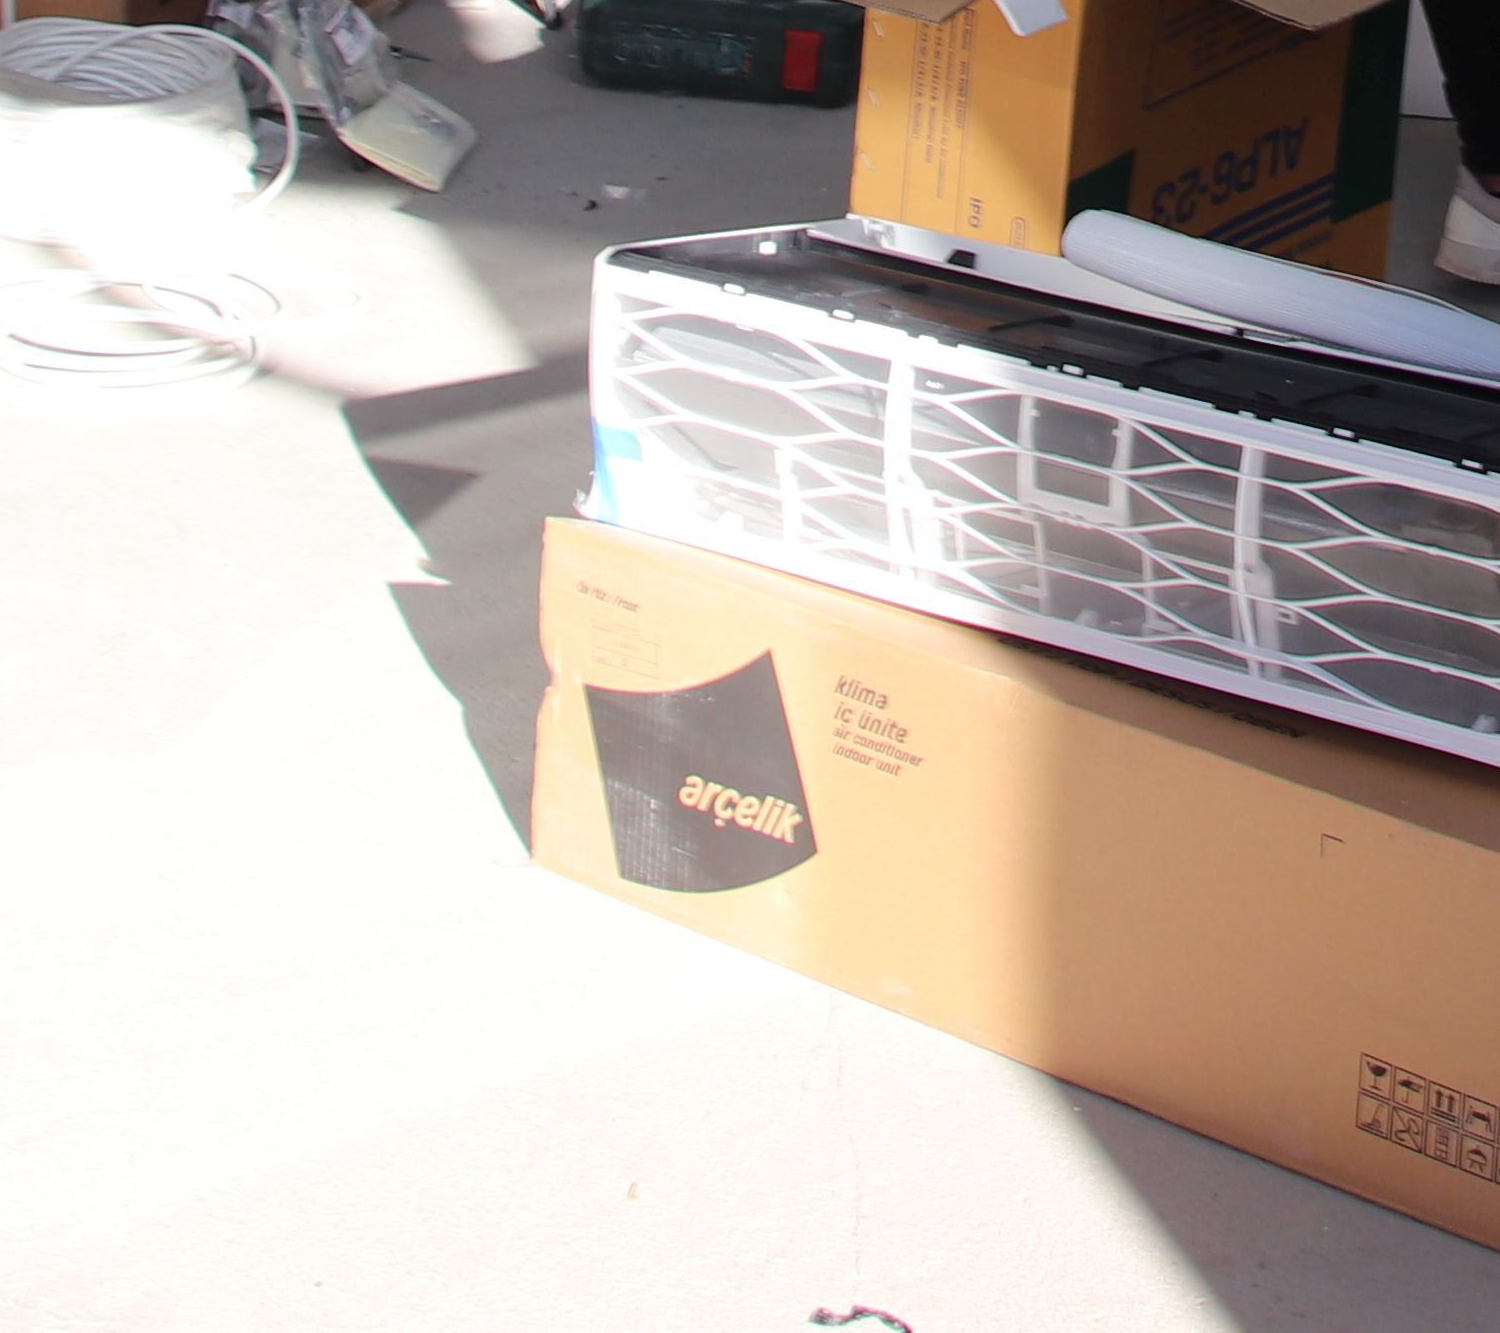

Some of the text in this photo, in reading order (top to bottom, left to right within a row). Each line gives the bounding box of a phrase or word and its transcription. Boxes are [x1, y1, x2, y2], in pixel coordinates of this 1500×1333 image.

[833, 675, 890, 711] klima
[856, 709, 910, 745] ünite
[852, 733, 926, 768] conditioner
[678, 773, 805, 845] arçelik
